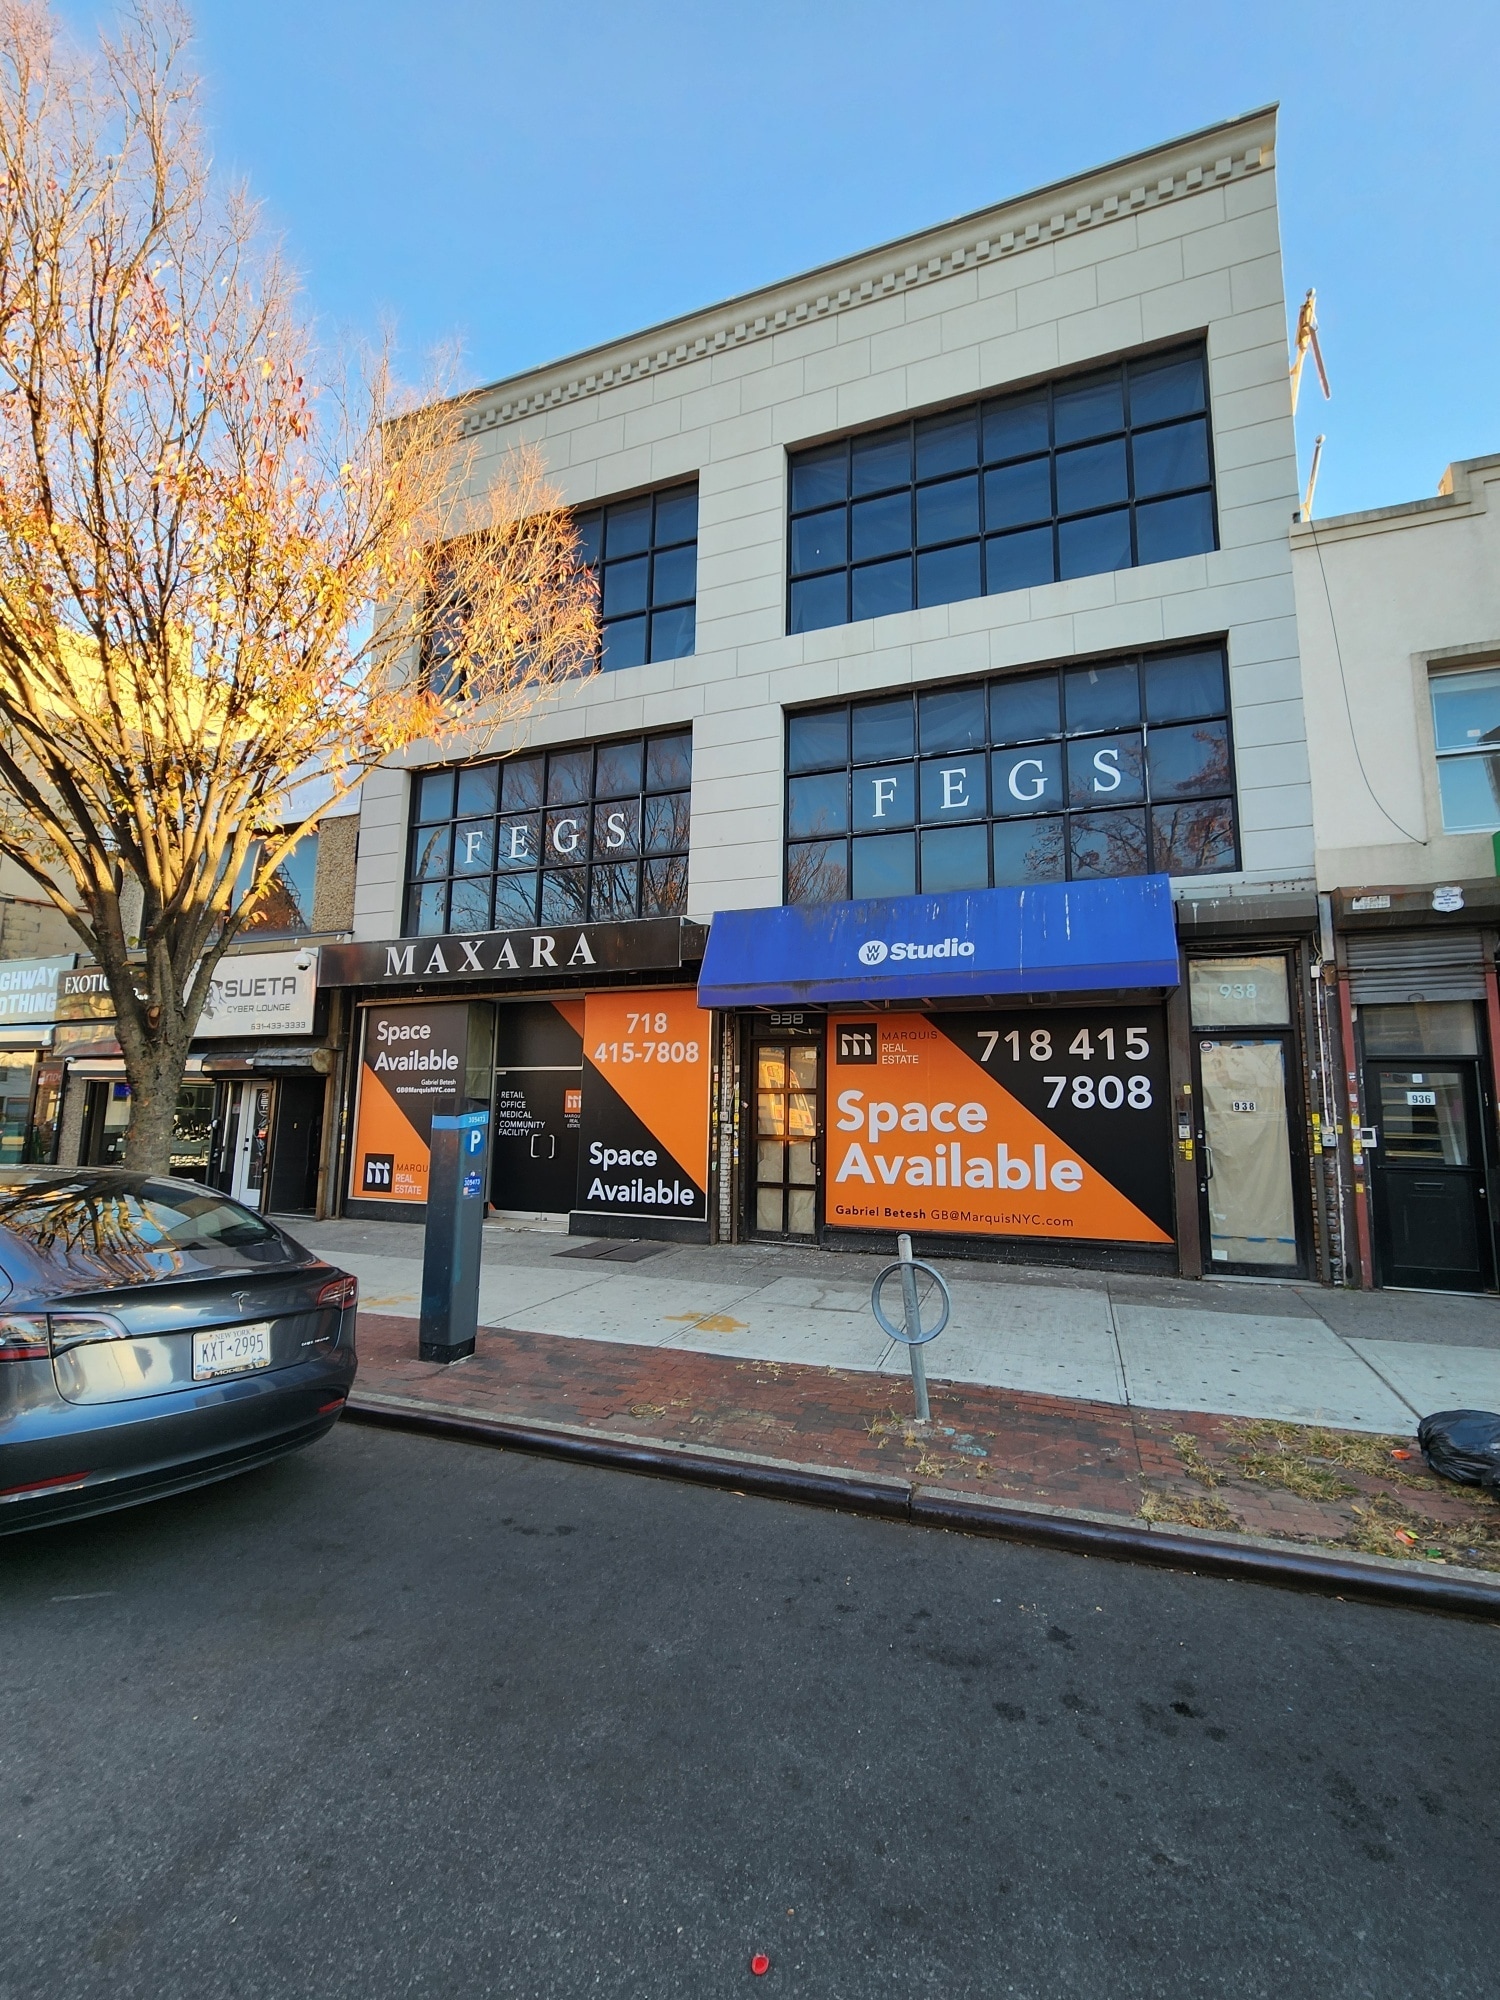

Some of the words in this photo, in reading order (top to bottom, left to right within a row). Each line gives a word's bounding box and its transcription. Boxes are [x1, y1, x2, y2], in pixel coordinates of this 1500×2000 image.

[872, 749, 1121, 818] FEGS
[464, 813, 626, 864] FEGS
[383, 932, 597, 977] MAXARA
[889, 938, 975, 960] Studio
[225, 976, 297, 998] SUETA
[1219, 983, 1257, 999] 938
[227, 1004, 254, 1013] CYBER
[256, 1003, 291, 1012] LOUNGE
[770, 1013, 804, 1025] 938
[376, 1020, 431, 1046] Space
[626, 1012, 668, 1034] 718
[881, 1030, 938, 1041] MARQUIS
[977, 1029, 1053, 1062] 718
[1068, 1027, 1150, 1061] 415
[594, 1041, 699, 1064] 415-7808
[881, 1043, 907, 1053] REAL
[374, 1048, 459, 1072] Available
[881, 1055, 919, 1065] ESTATE
[500, 1091, 525, 1099] RETAIL
[1042, 1075, 1153, 1110] 7808
[1412, 1095, 1431, 1104] 936
[499, 1111, 533, 1119] MEDICAL
[500, 1101, 526, 1109] OFFICE
[836, 1089, 988, 1143] Space
[1234, 1102, 1256, 1112] 938
[498, 1129, 530, 1137] FACILITY
[499, 1121, 546, 1129] COMMUNITY
[470, 1130, 481, 1153] P
[588, 1141, 658, 1171] Space
[835, 1142, 1084, 1192] Available
[394, 1185, 422, 1195] ESTATE
[395, 1174, 414, 1184] REAL
[587, 1177, 695, 1206] Available
[835, 1205, 880, 1217] Gabriel
[884, 1207, 927, 1219] Betesh
[930, 1209, 1075, 1227] GB@MarquisNYC.com
[215, 1331, 233, 1340] NEW
[233, 1328, 251, 1337] YORK
[202, 1341, 225, 1363] KXT
[234, 1333, 264, 1357] 2995
